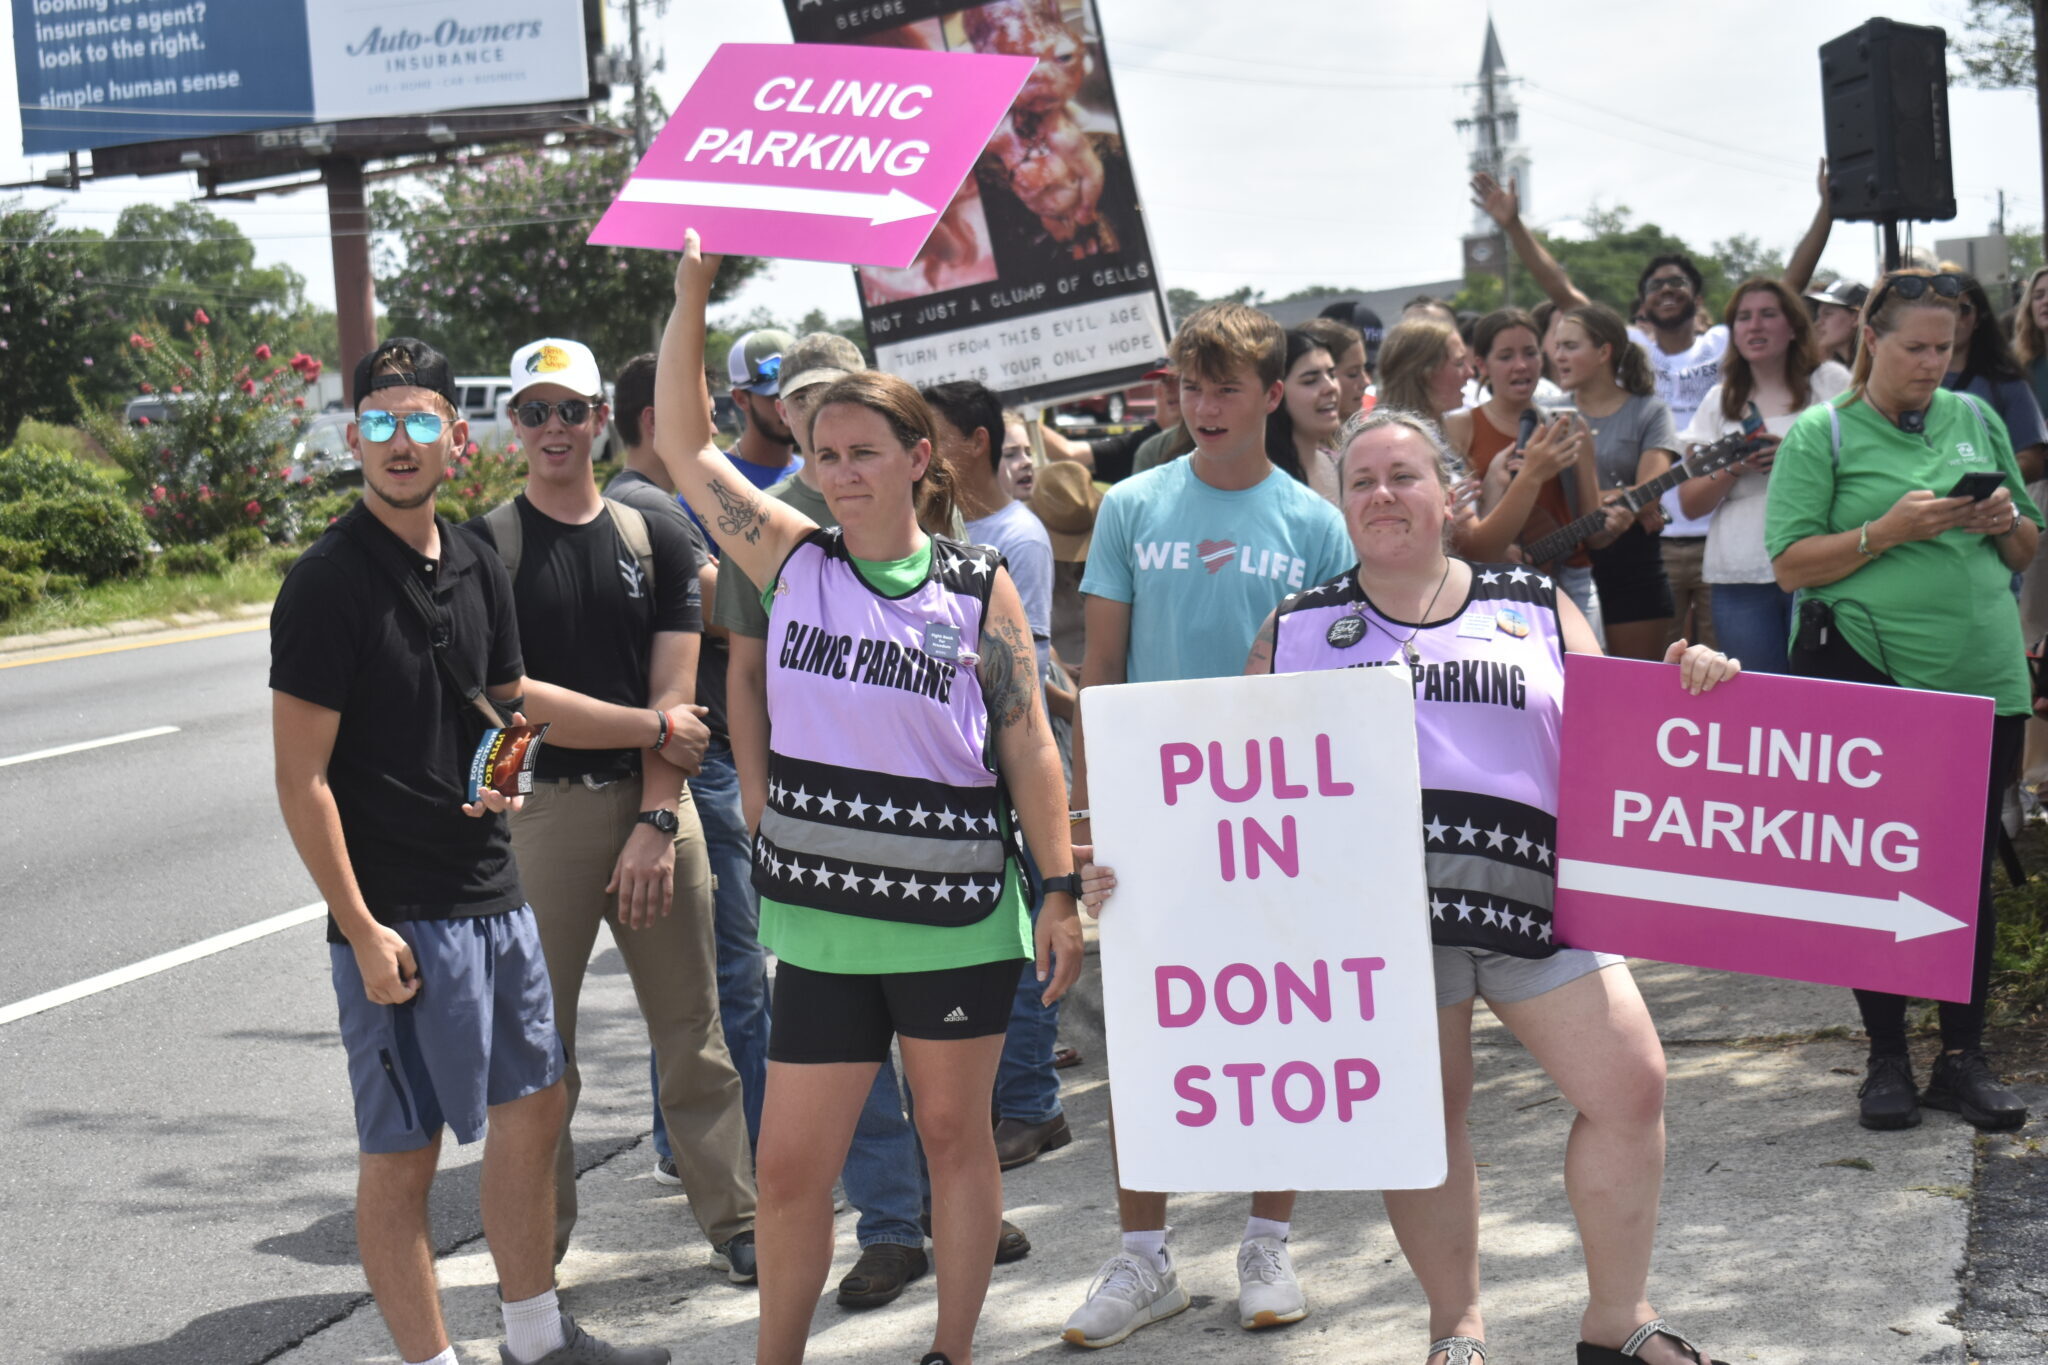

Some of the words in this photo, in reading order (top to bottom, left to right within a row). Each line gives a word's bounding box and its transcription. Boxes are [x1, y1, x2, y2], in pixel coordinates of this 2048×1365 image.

[35, 14, 132, 42] insurance
[136, 3, 206, 33] agent?
[346, 18, 542, 57] Auto-Owners
[836, 1, 905, 30] BEFORE
[39, 45, 82, 69] look
[87, 43, 108, 62] to
[112, 37, 145, 58] the
[150, 30, 206, 58] right.
[386, 48, 505, 73] INSURANCE
[39, 82, 104, 109] simple
[109, 78, 177, 100] human
[753, 76, 933, 120] CLINIC
[685, 127, 930, 177] PARKING
[871, 314, 902, 334] NOT
[916, 301, 957, 325] JUST
[970, 299, 981, 312] A
[990, 285, 1046, 308] CLUMP
[1057, 277, 1079, 294] OF
[1093, 262, 1149, 287] CELLS
[895, 347, 937, 368] TURN
[950, 338, 990, 358] FROM
[999, 329, 1041, 347] THIS
[1054, 316, 1097, 338] EVIL
[1109, 306, 1142, 325] AGE
[969, 366, 989, 382] IS
[1000, 357, 1042, 377] YOUR
[1054, 346, 1096, 367] ONLY
[1109, 335, 1153, 357] HOPE
[1134, 542, 1190, 570] WE
[1240, 546, 1306, 588] LIFE
[780, 620, 852, 680] CLINIC
[850, 638, 957, 705] PARKING
[1410, 660, 1526, 711] PARKING
[470, 747, 484, 780] EQUAL
[490, 734, 506, 760] ALL!
[1159, 733, 1355, 806] PULL
[1656, 717, 1883, 788] CLINIC
[1217, 814, 1299, 882] IN
[1612, 790, 1919, 873] PARKING
[1154, 956, 1386, 1029] DONT
[1173, 1057, 1381, 1128] STOP
